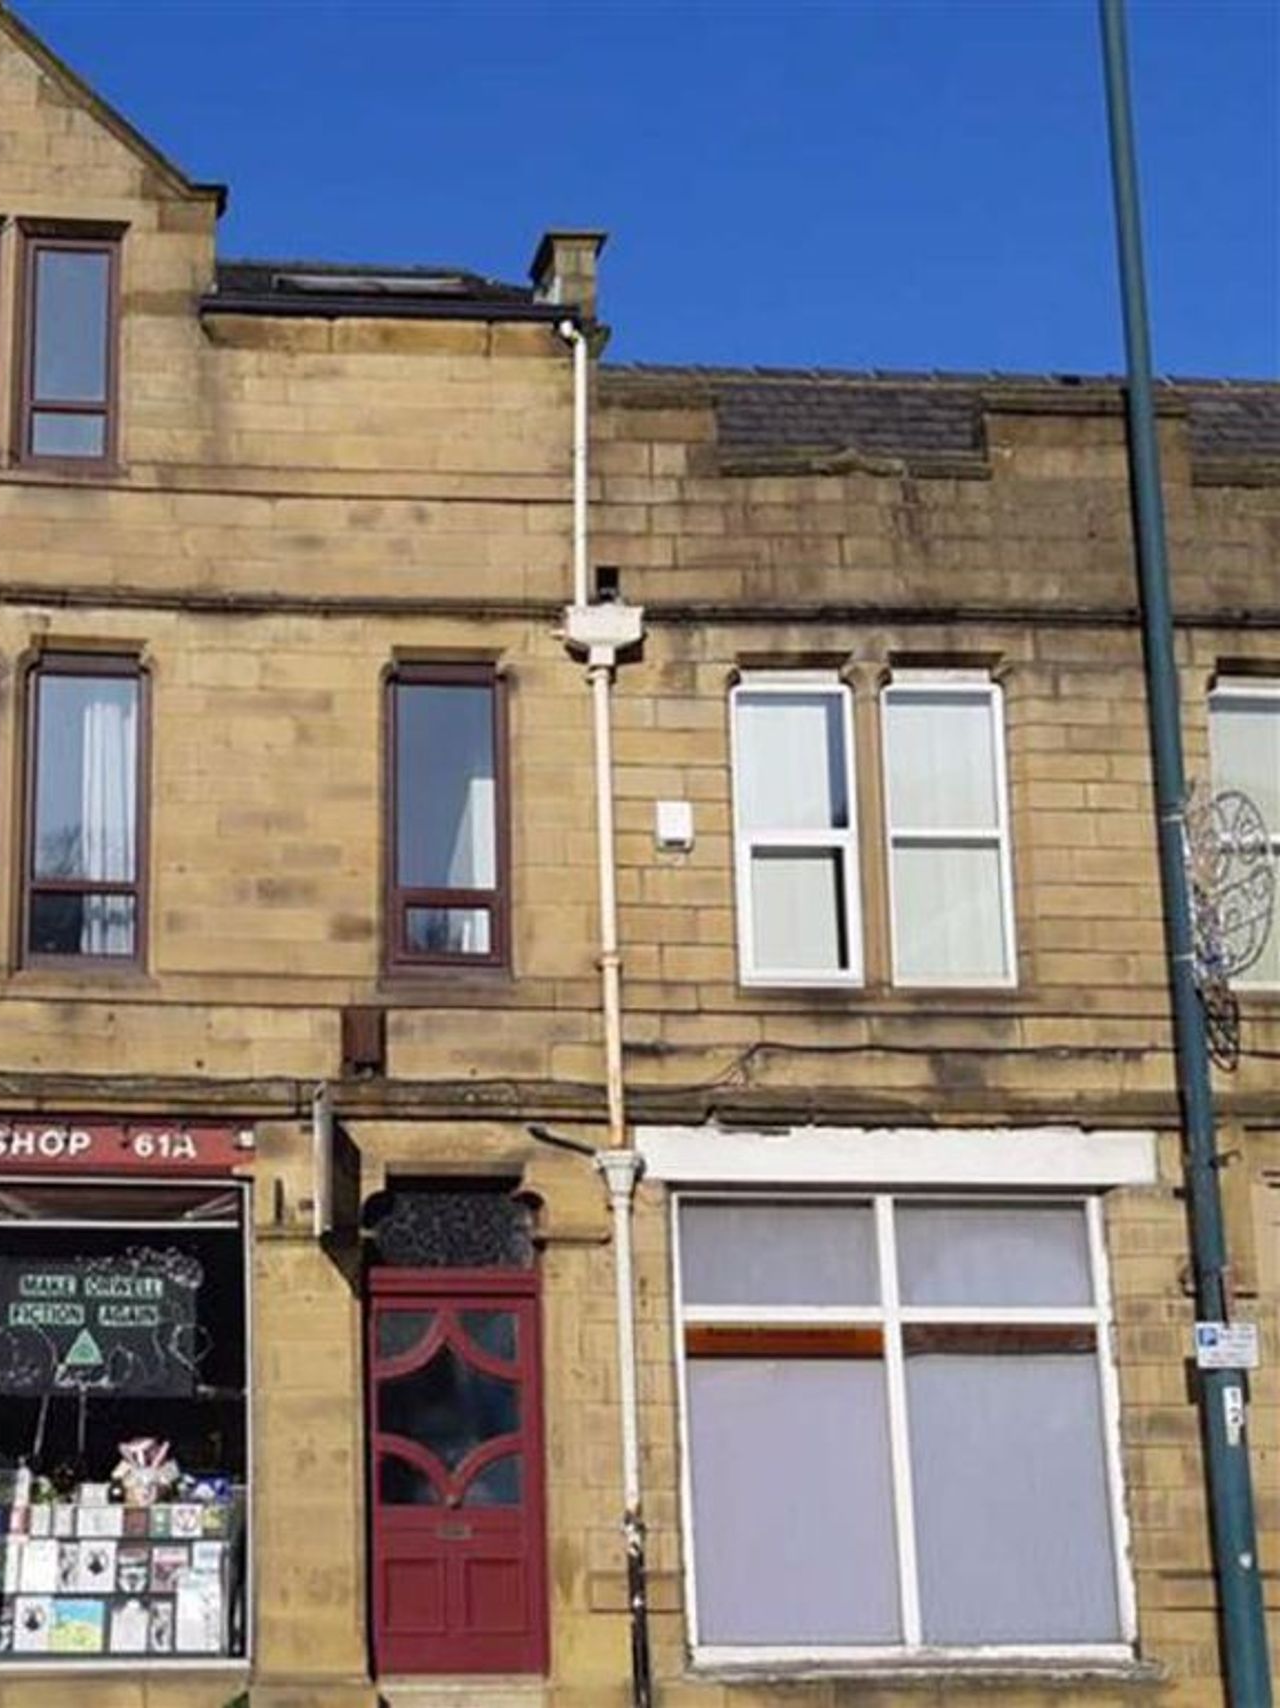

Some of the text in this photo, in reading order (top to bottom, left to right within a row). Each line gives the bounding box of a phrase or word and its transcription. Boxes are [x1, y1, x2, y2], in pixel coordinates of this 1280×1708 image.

[134, 1132, 197, 1159] 61A
[21, 1274, 76, 1296] MAKE
[9, 1302, 85, 1326] FICTION
